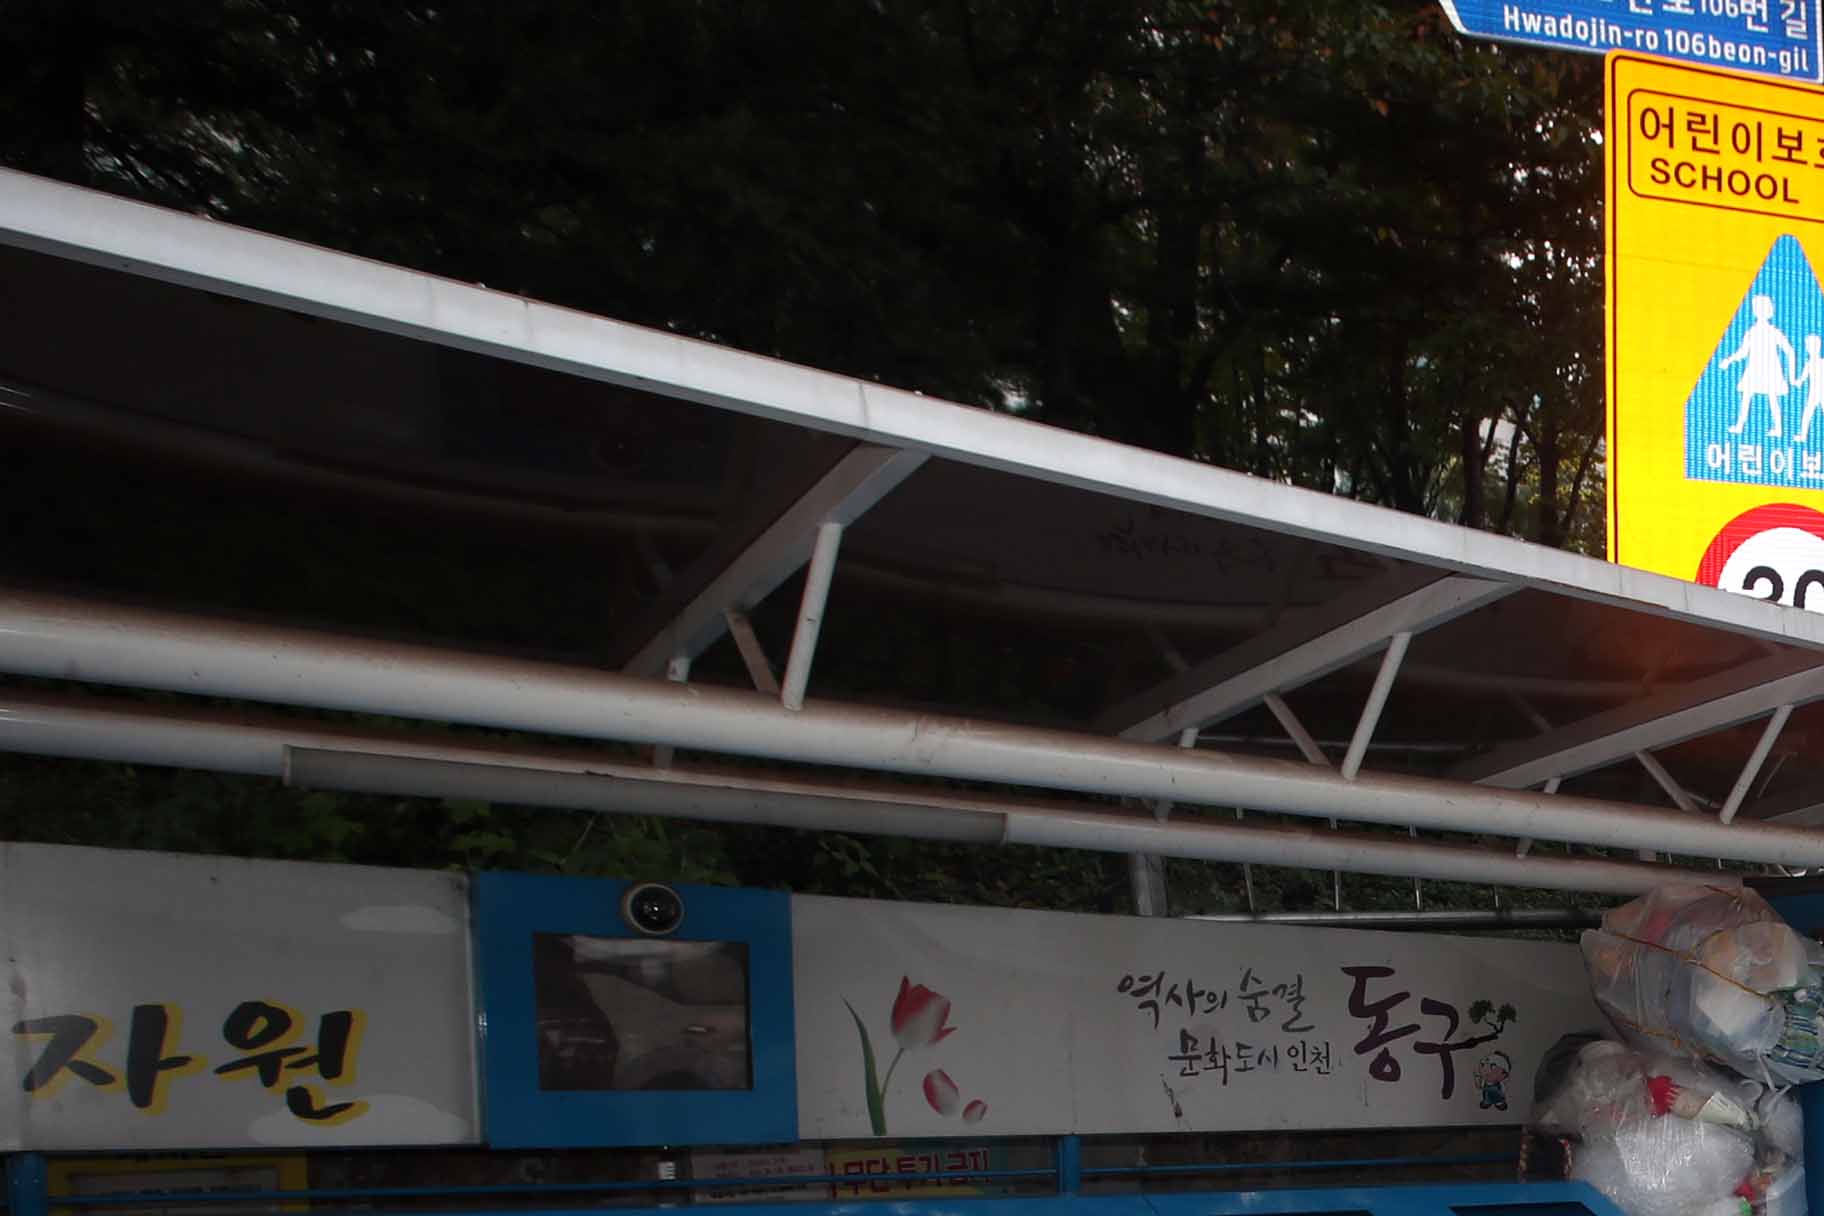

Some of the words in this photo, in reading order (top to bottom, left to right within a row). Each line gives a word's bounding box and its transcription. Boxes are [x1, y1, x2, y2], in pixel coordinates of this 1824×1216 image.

[1502, 5, 1659, 51] Hwadojin-ro
[1663, 28, 1809, 73] 106beon-gil
[1650, 157, 1800, 204] SCHOOL
[1117, 971, 1228, 1030] 역사의
[1237, 967, 1316, 1033] 숨결
[1341, 964, 1470, 1100] 동구
[11, 1001, 366, 1122] 자원
[1168, 1028, 1279, 1086] 문화도시
[1287, 1041, 1332, 1075] 인천
